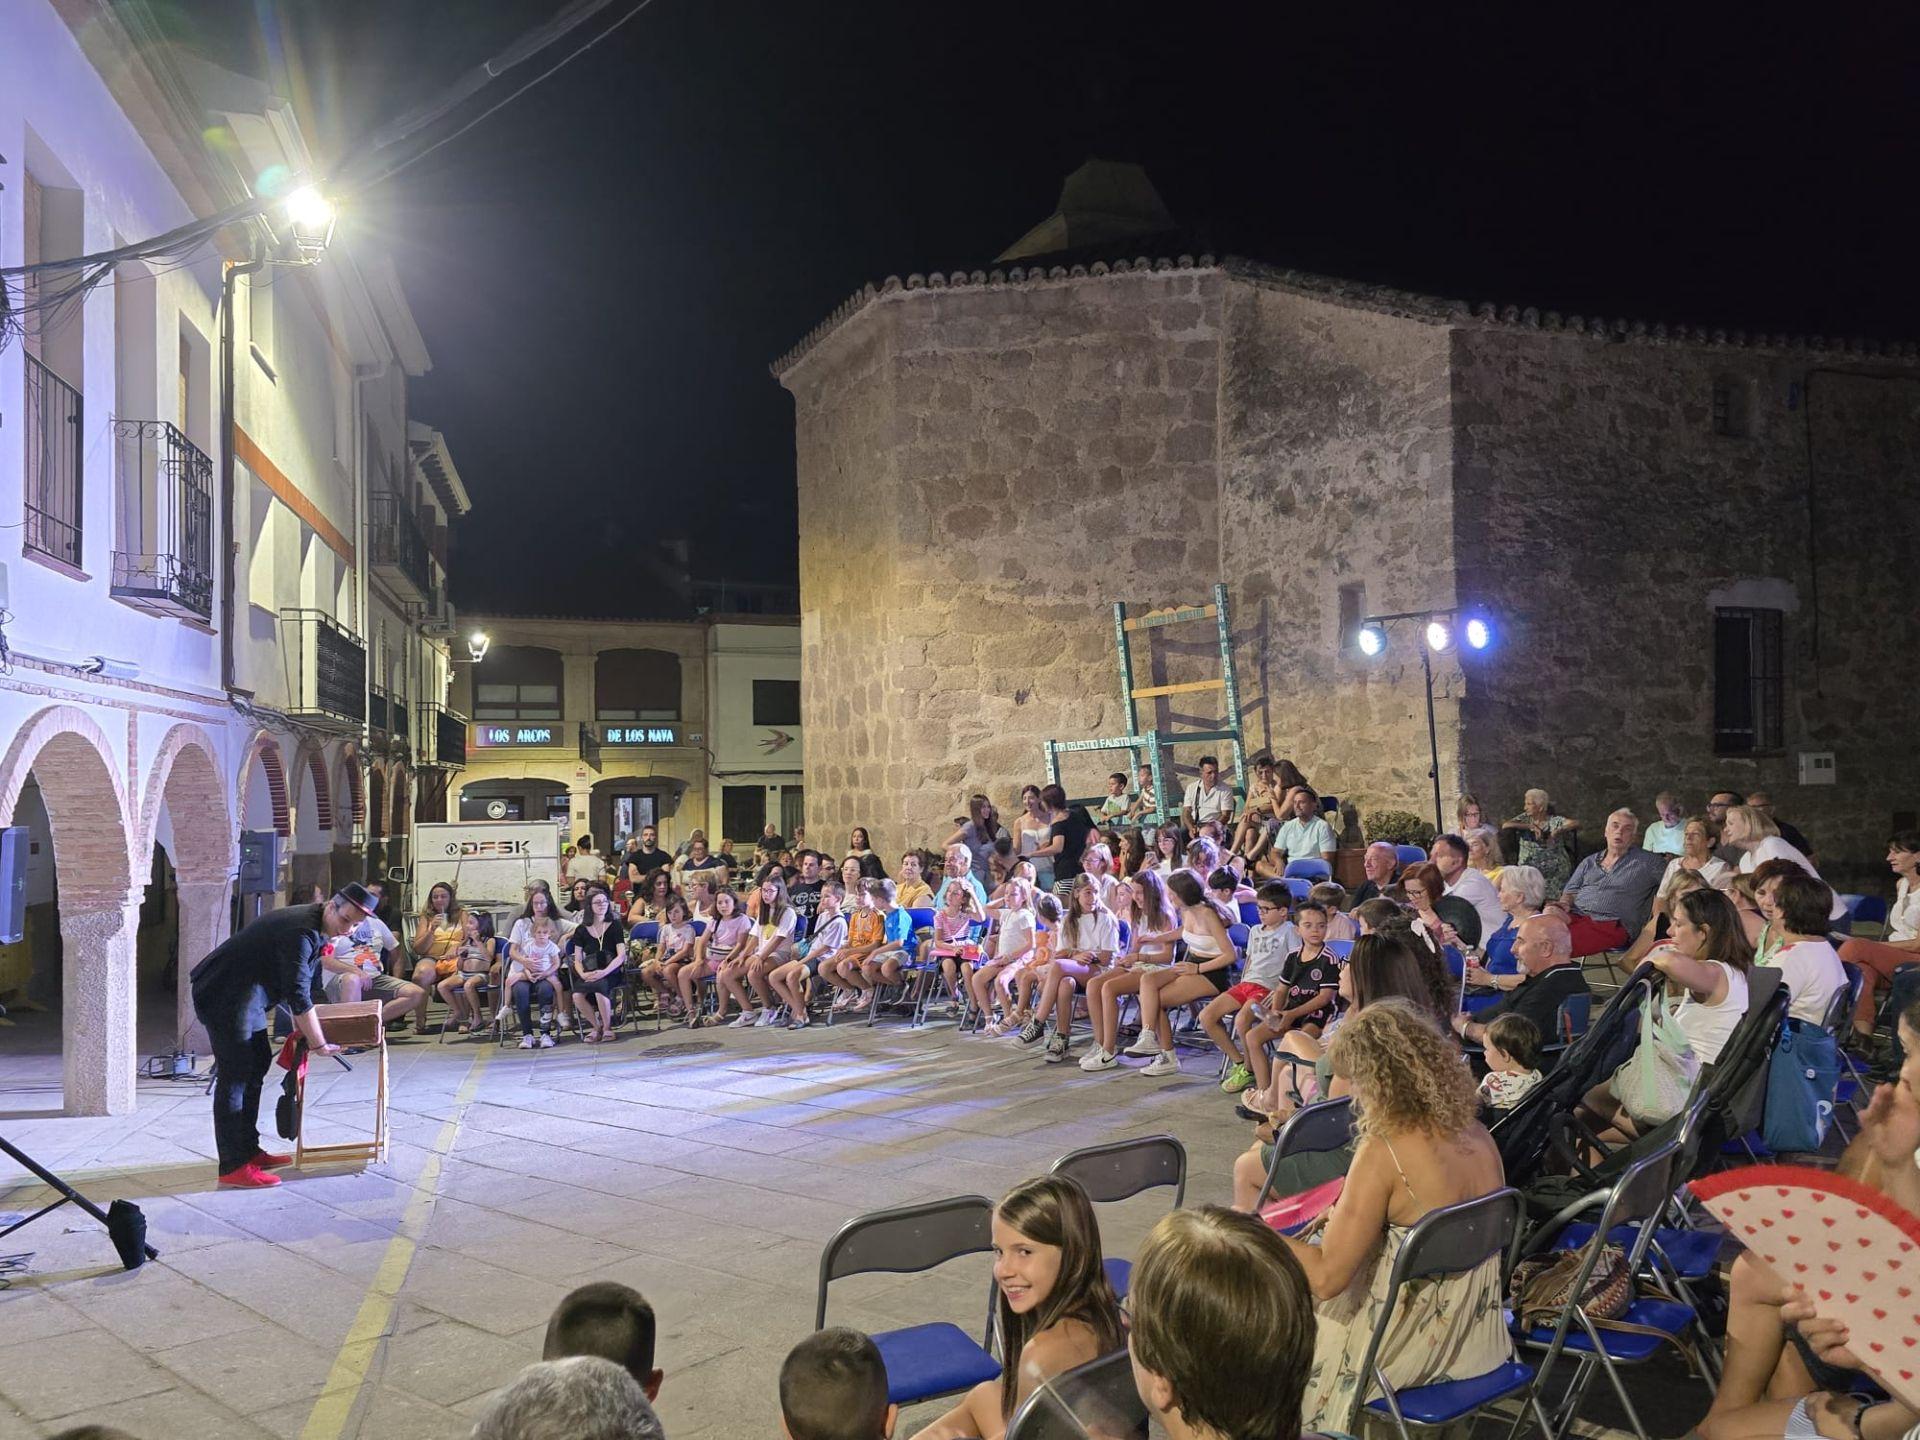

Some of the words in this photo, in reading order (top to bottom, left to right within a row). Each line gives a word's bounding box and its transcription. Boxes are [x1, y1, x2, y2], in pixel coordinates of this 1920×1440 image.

[488, 729, 510, 743] LOS
[517, 729, 552, 743] ARCOS
[607, 729, 622, 743] DE
[625, 729, 645, 743] LOS
[648, 729, 674, 743] NAVA
[461, 840, 531, 855] DFSK
